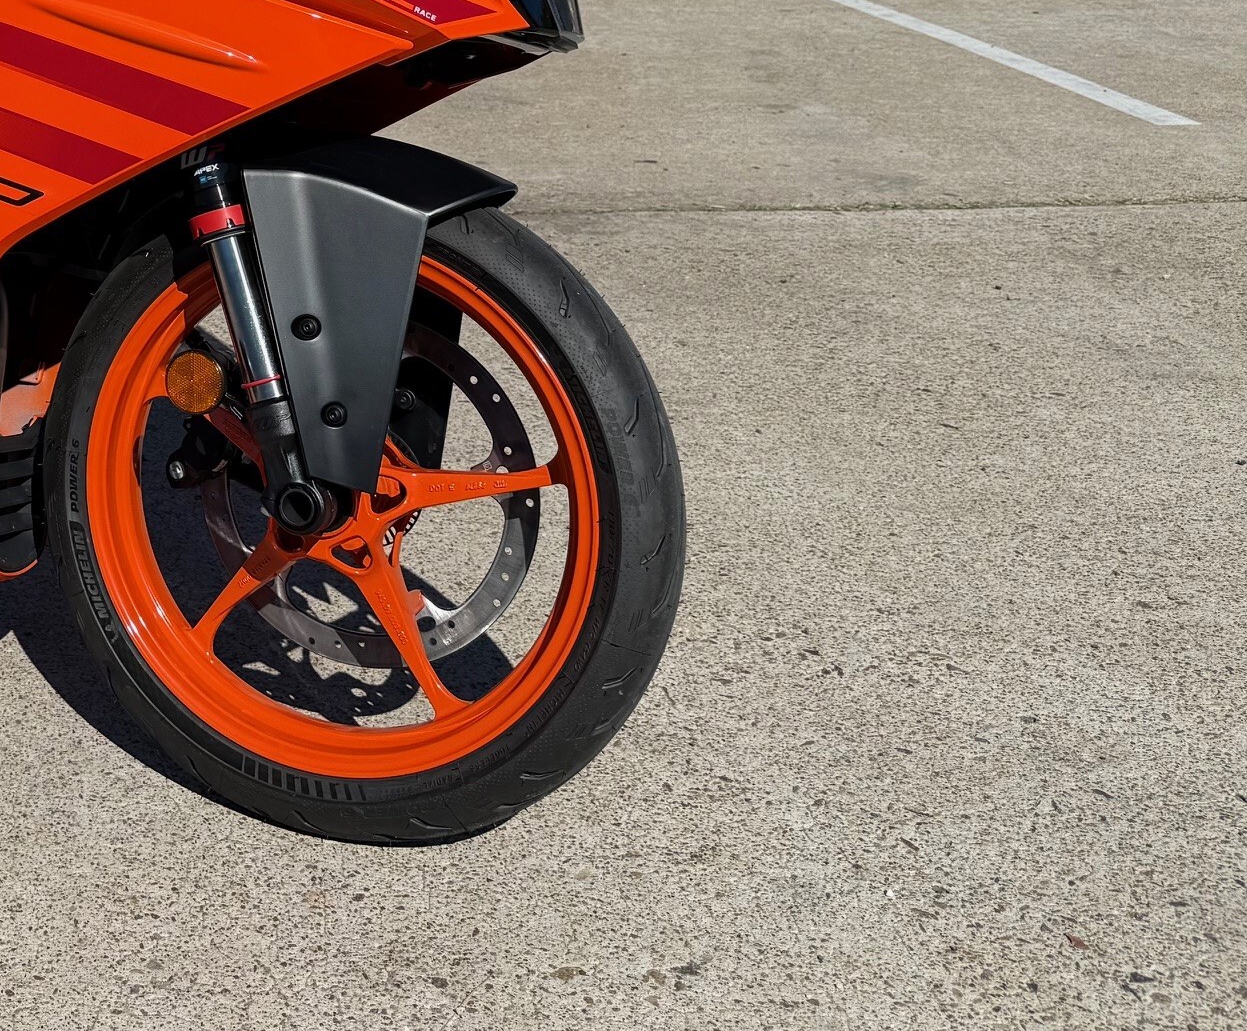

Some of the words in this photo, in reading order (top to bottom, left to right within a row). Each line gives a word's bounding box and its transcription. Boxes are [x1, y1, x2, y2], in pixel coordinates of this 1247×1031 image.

[413, 6, 438, 22] RACE
[193, 163, 220, 177] APEX
[72, 438, 80, 448] 6
[70, 451, 80, 513] POWER
[72, 529, 110, 619] MICHELIN
